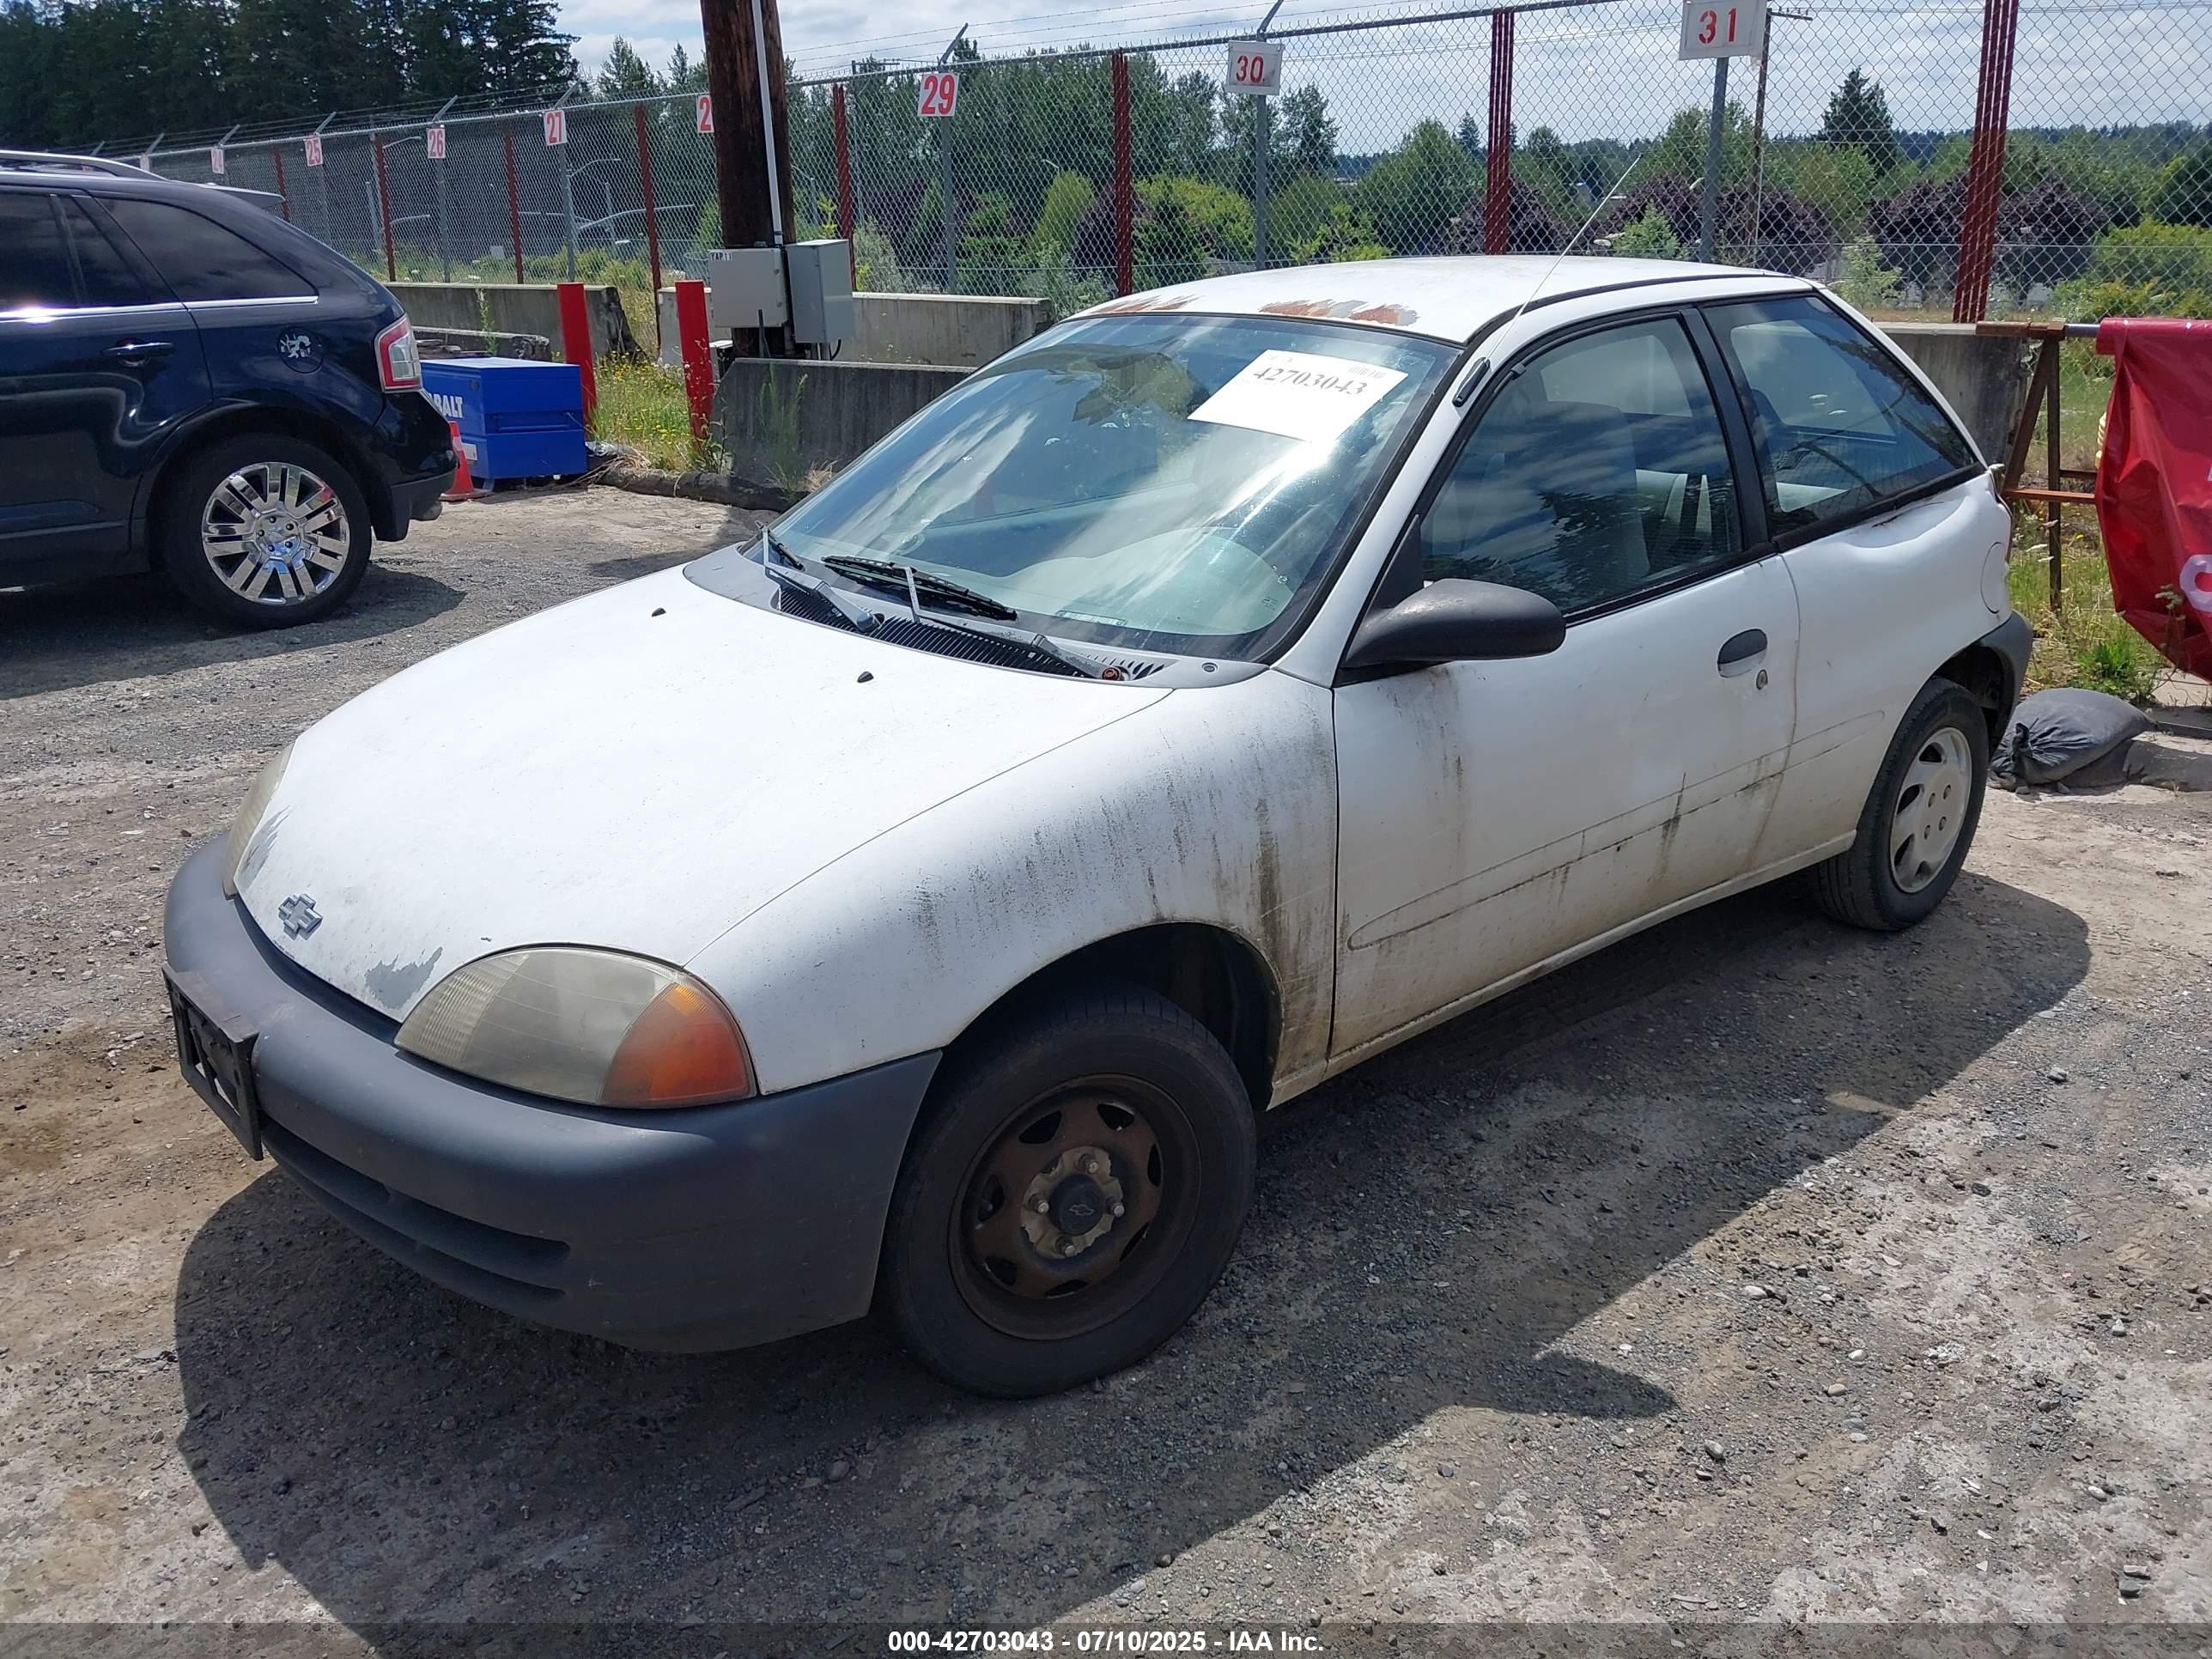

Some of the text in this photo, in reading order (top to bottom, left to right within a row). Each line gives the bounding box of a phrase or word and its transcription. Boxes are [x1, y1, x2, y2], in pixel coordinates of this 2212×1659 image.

[1698, 8, 1737, 44] 31
[1236, 55, 1264, 82] 30
[921, 75, 955, 114] 29
[546, 112, 563, 143] 27
[700, 96, 712, 131] 2
[307, 137, 321, 165] 25
[429, 131, 444, 157] 26
[1253, 367, 1368, 395] 42703043
[428, 392, 463, 418] BALT
